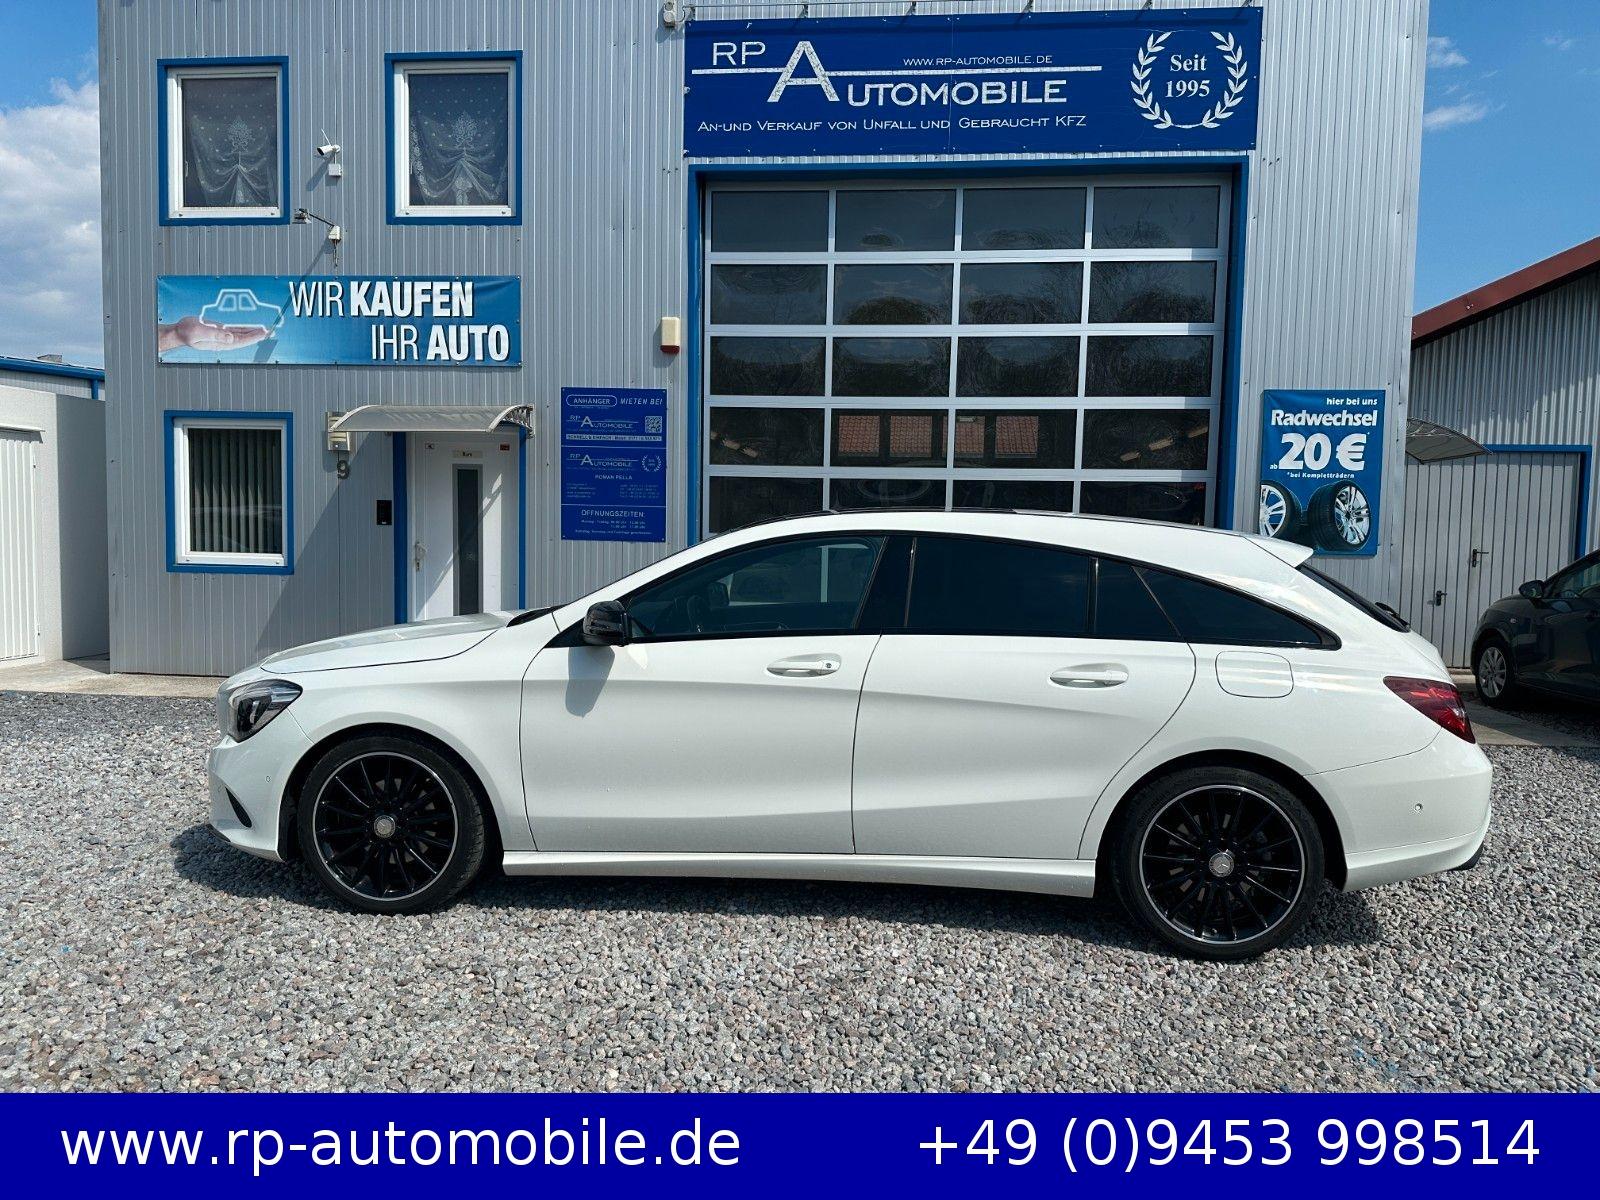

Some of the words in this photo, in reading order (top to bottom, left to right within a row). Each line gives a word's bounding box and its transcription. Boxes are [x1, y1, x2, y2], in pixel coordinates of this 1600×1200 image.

[712, 41, 766, 66] RP
[903, 55, 1053, 66] WWW.RP-AUTOMOBILE.DE
[1169, 54, 1207, 72] Seit
[1165, 79, 1210, 98] 1995
[757, 121, 823, 131] VERKAUF
[828, 121, 857, 131] VON
[863, 119, 916, 130] UNFALL
[920, 119, 951, 129] UND
[958, 117, 1050, 129] GEBRAUCHT
[1055, 115, 1087, 127] KFZ
[289, 281, 345, 318] WIR
[350, 281, 475, 318] KAUFEN
[371, 325, 419, 361] IHR
[426, 324, 511, 362] AUTO
[620, 397, 648, 406] MIETEN
[649, 398, 663, 406] BEI
[1327, 397, 1344, 405] hier
[1271, 409, 1378, 426] Radwechsel
[1279, 433, 1332, 470] 20
[337, 459, 350, 480] 9
